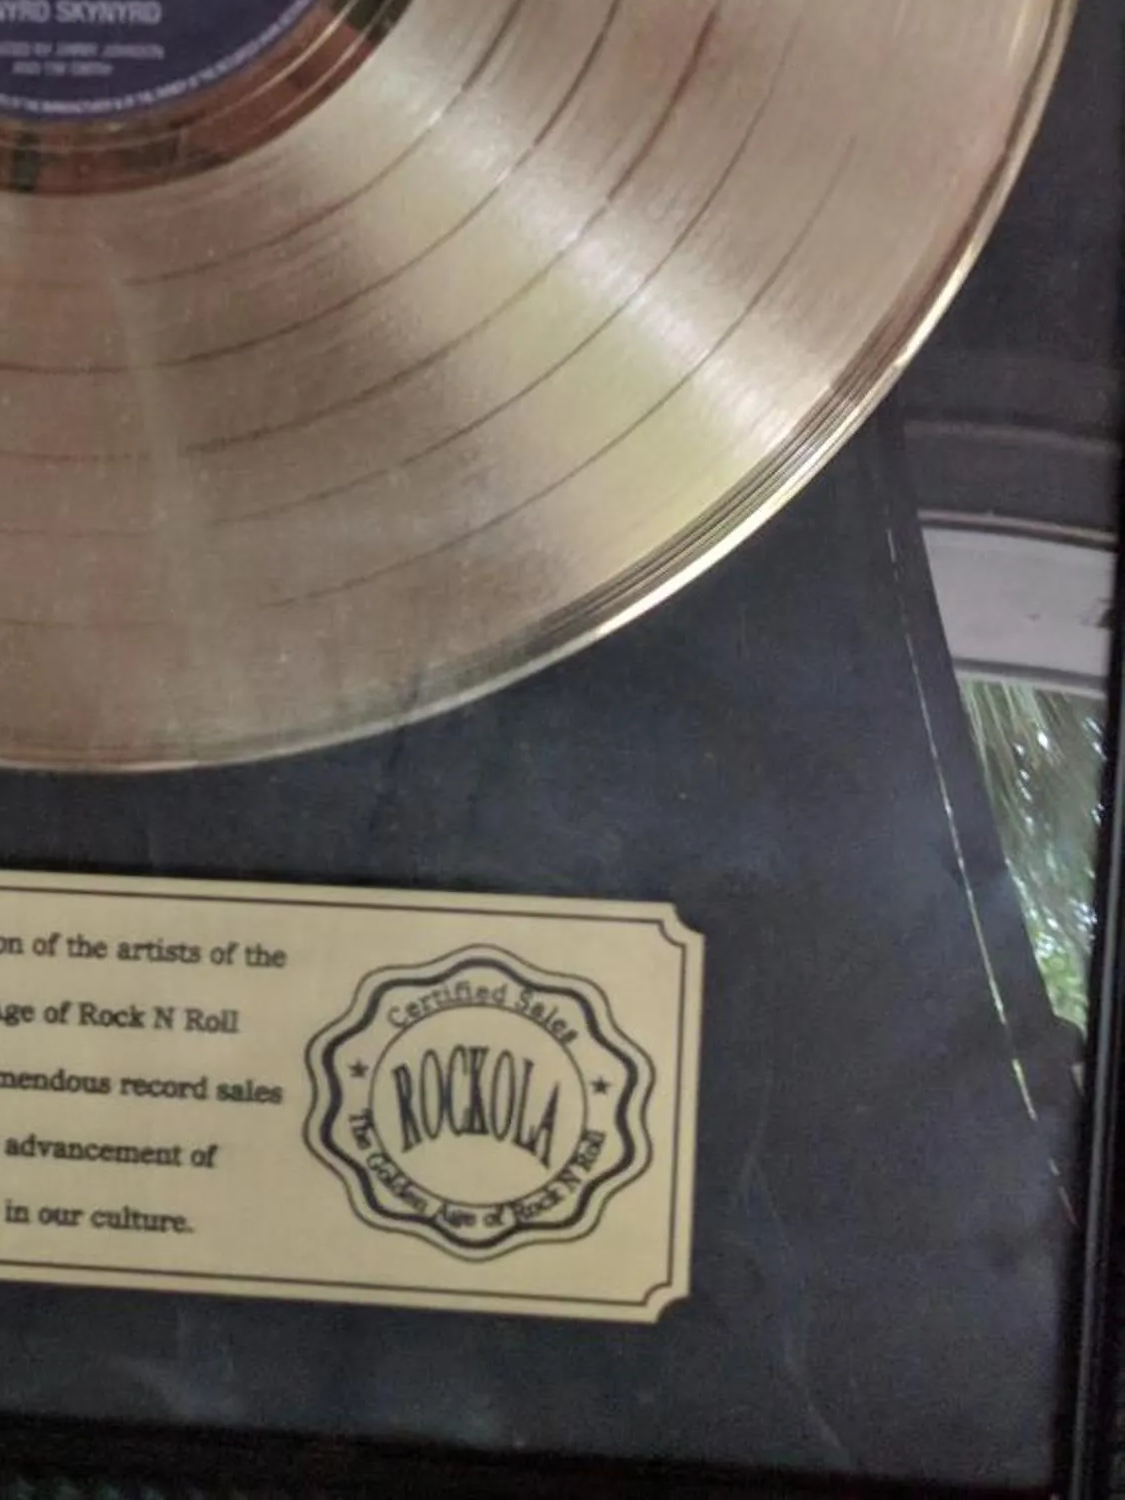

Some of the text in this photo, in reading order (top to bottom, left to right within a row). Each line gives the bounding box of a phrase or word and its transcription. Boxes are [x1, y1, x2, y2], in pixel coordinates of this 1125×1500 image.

[32, 932, 62, 957] of
[66, 933, 108, 960] the
[116, 938, 202, 964] artists
[209, 941, 240, 966] of
[244, 943, 288, 969] the
[43, 1000, 73, 1025] of
[77, 1002, 146, 1029] Rock
[153, 1006, 175, 1030] N
[184, 1008, 239, 1034] Roll
[387, 980, 579, 1044] Certified Sales
[119, 1076, 210, 1101] record
[215, 1079, 284, 1105] sales
[391, 1045, 561, 1169] ROCKOLA
[4, 1133, 184, 1167] advancement
[190, 1143, 220, 1169] of
[4, 1199, 31, 1225] in
[37, 1207, 84, 1227] our
[89, 1205, 195, 1235] culture.
